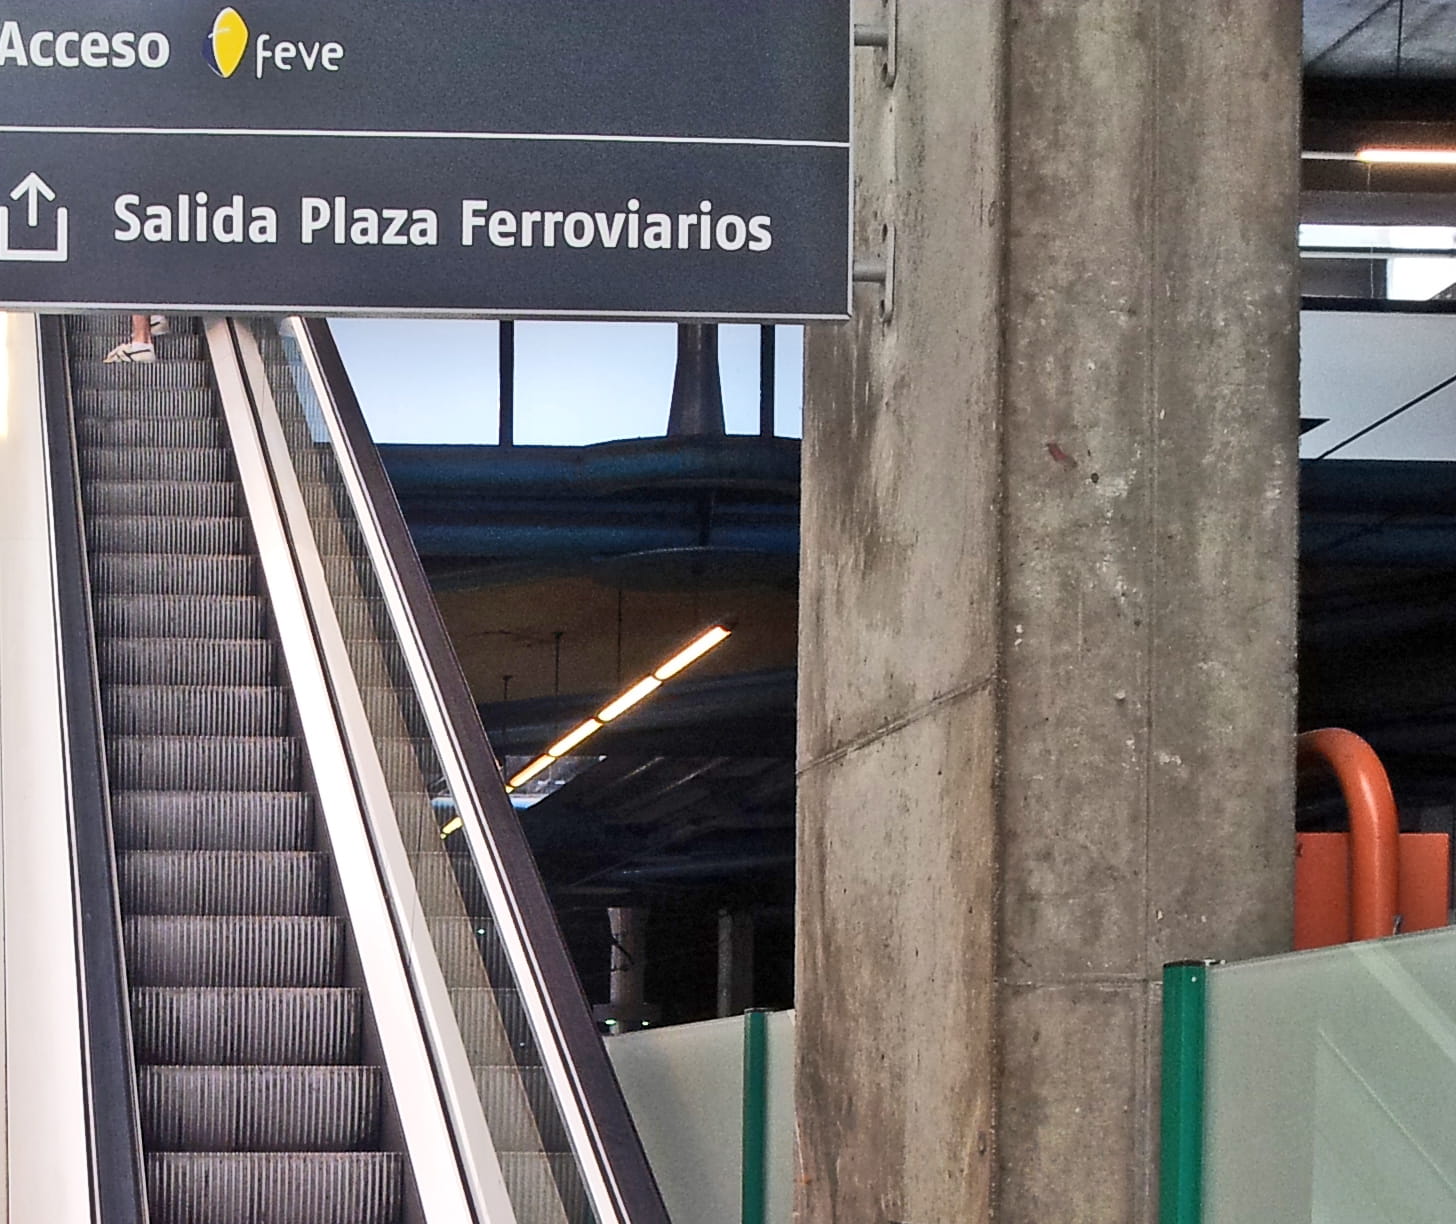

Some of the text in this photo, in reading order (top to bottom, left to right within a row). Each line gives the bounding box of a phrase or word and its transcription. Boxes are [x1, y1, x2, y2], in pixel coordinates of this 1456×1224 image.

[256, 33, 345, 79] feve
[115, 192, 772, 252] Salida Plaza Ferroviarios
